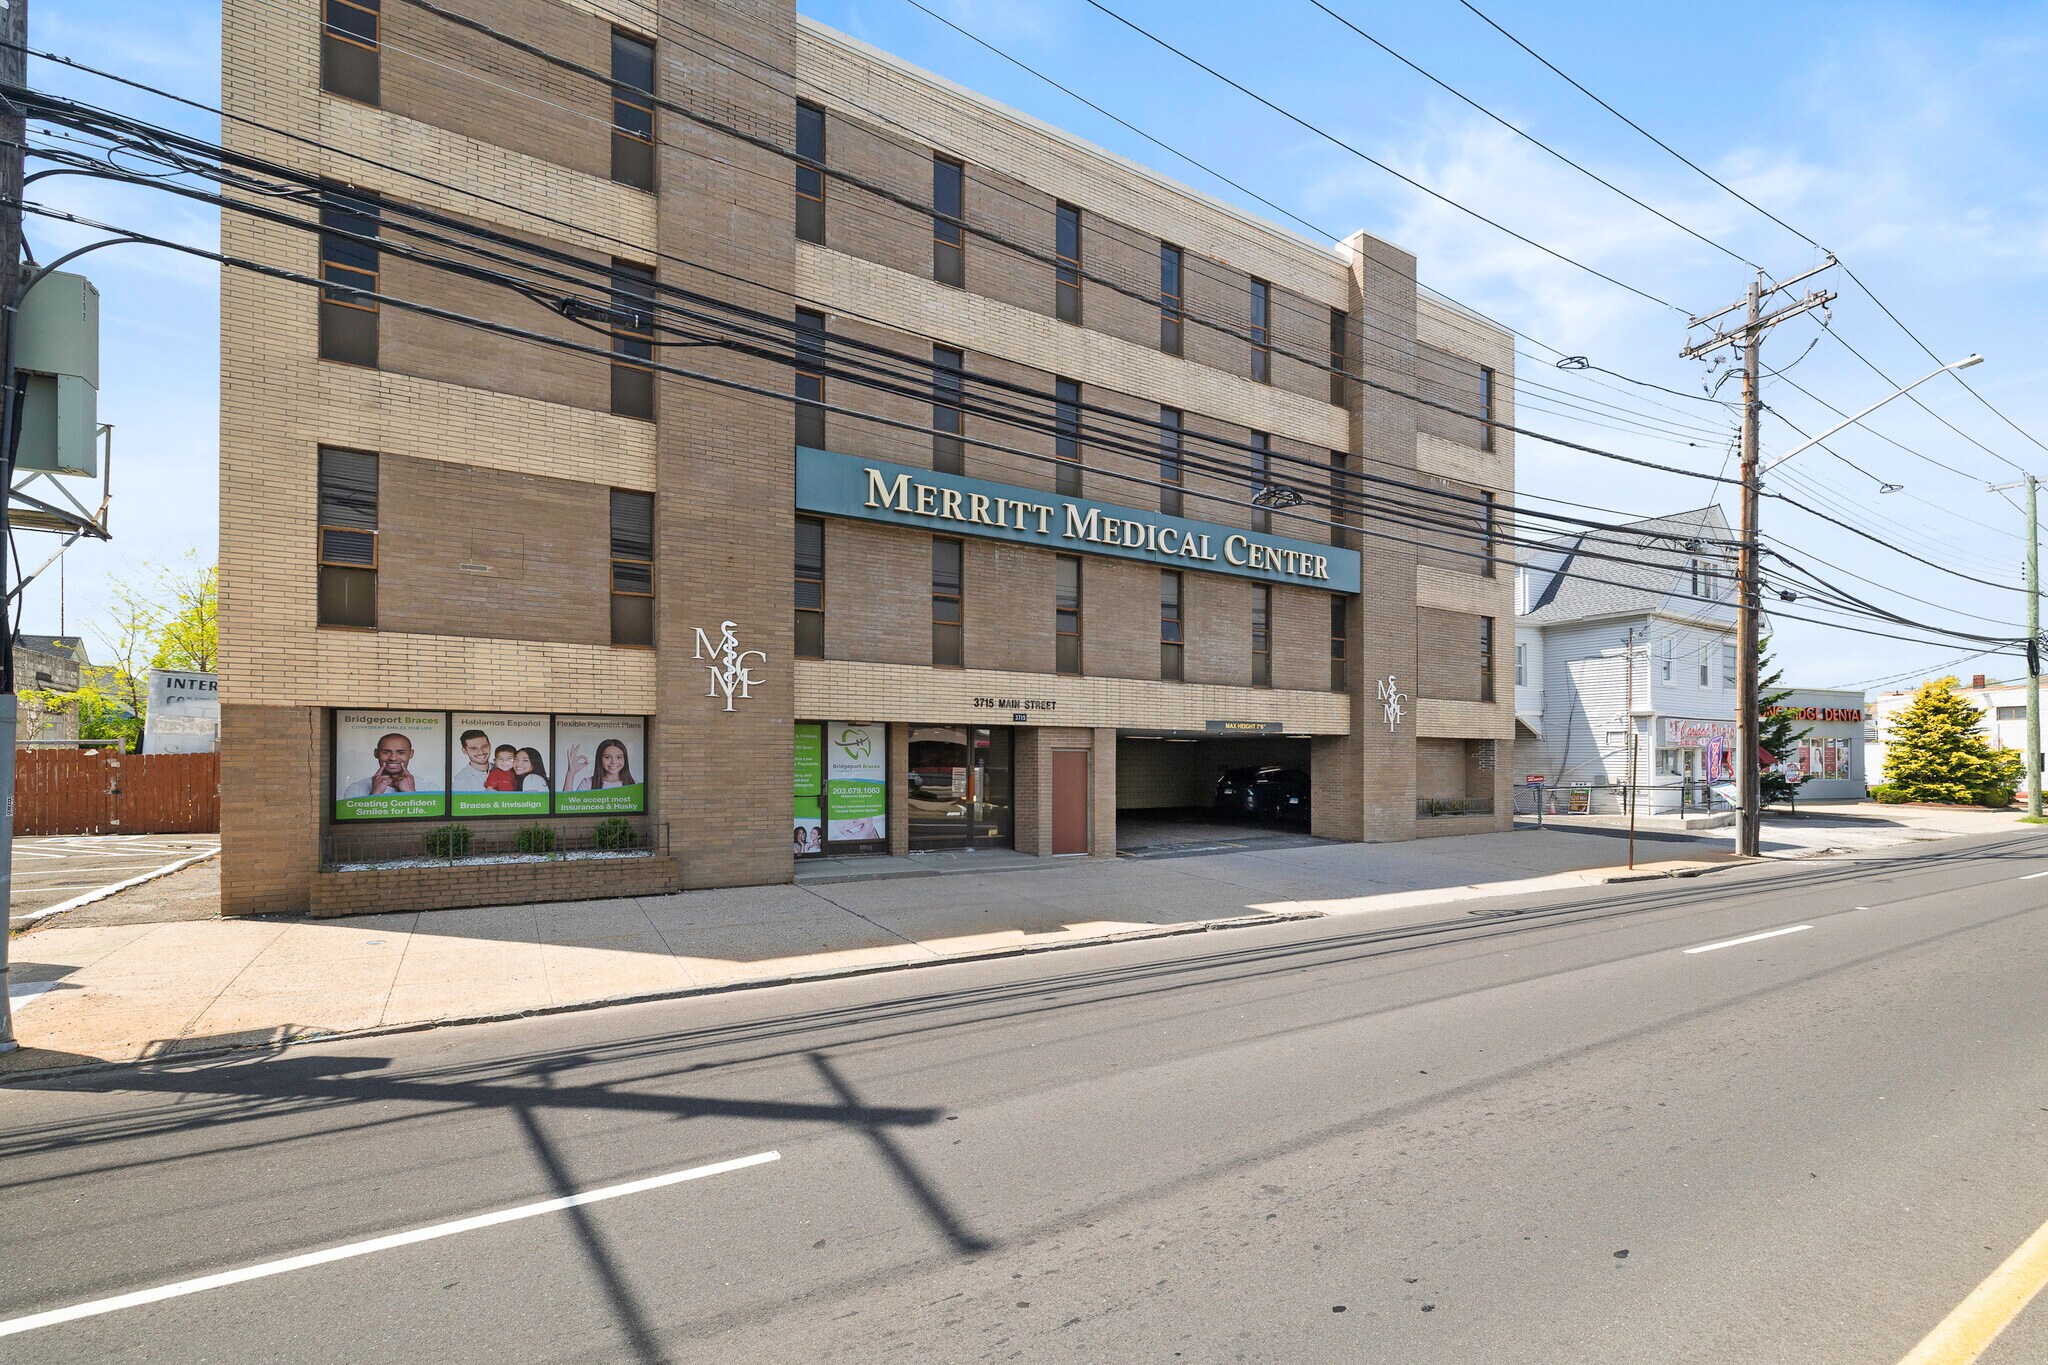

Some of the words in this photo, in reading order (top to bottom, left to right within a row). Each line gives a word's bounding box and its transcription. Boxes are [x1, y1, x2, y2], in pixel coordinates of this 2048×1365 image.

[863, 467, 1055, 534] MERRITT
[1062, 503, 1217, 561] MEDICAL
[1224, 534, 1330, 580] CENTER
[974, 698, 994, 708] 3715
[998, 699, 1020, 708] MAIN
[1024, 700, 1056, 710] STREET
[1825, 708, 1864, 722] DENTAL
[344, 716, 402, 724] Bridgeport
[508, 719, 540, 728] Español
[588, 722, 620, 730] Payment
[346, 800, 388, 808] Creating
[502, 801, 542, 809] Invisalign
[614, 803, 638, 811] Husky
